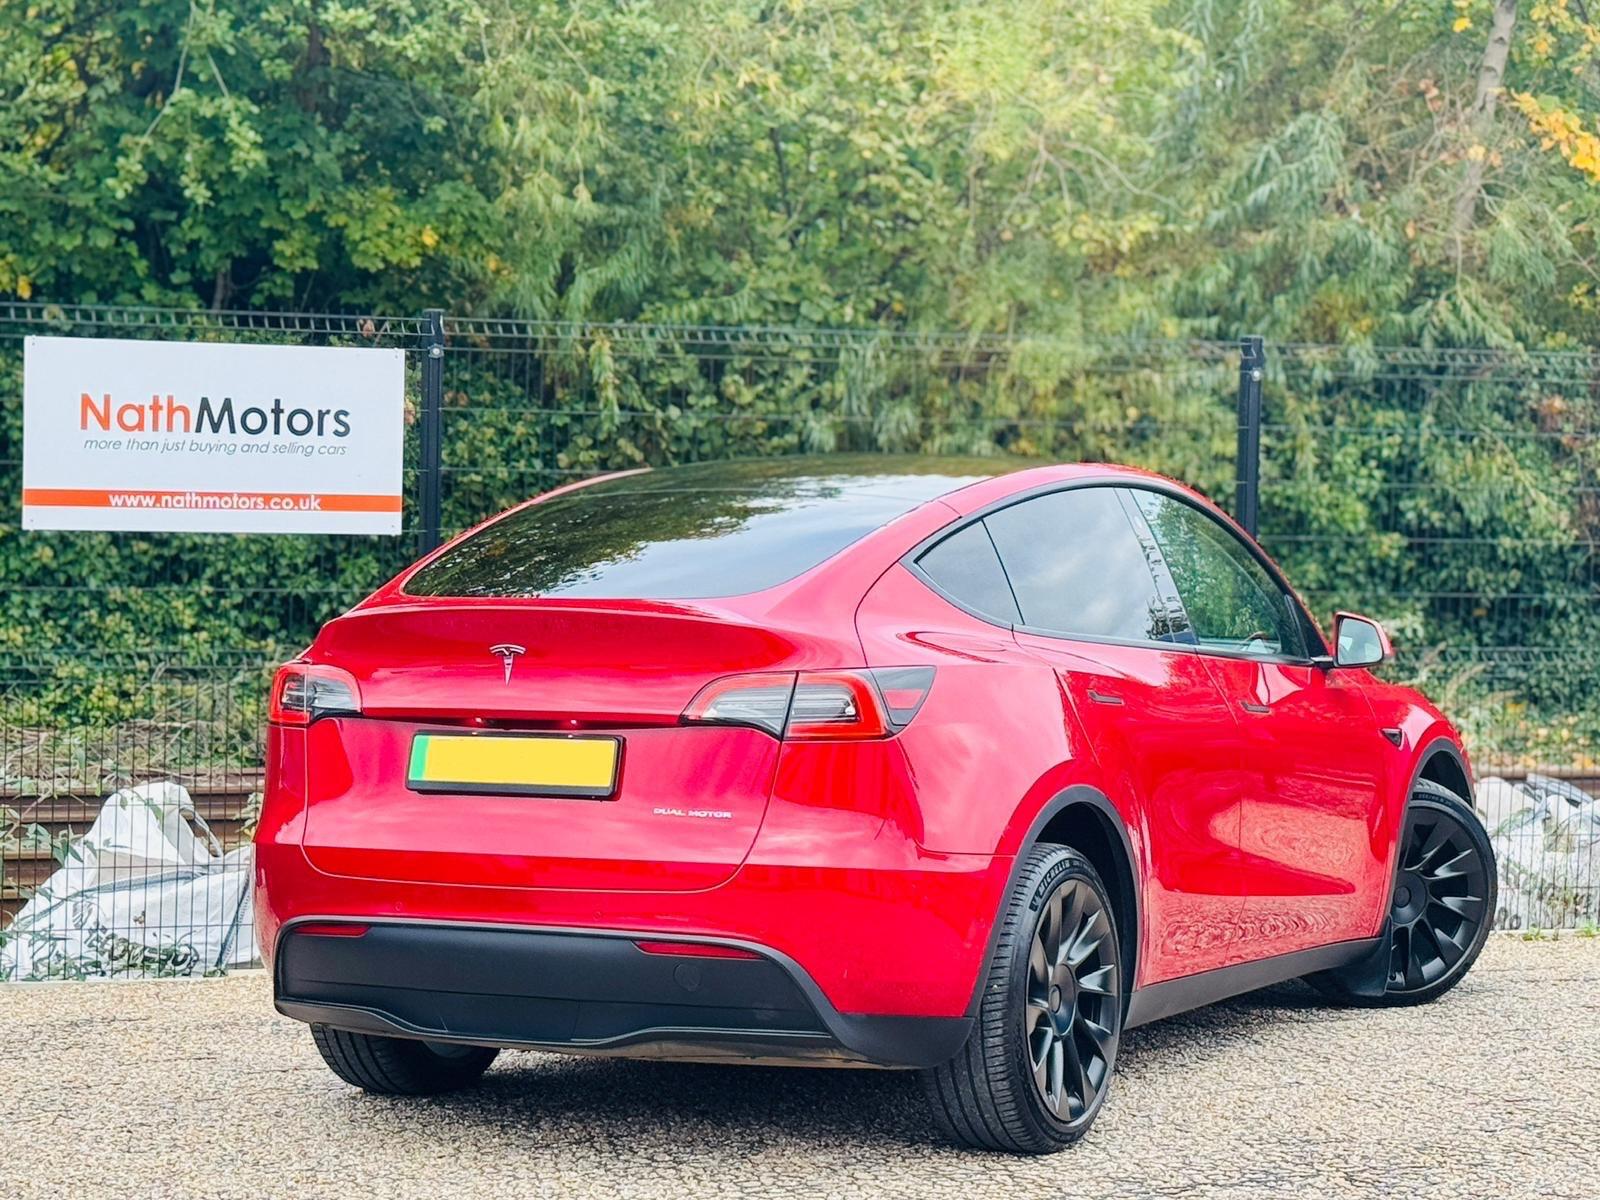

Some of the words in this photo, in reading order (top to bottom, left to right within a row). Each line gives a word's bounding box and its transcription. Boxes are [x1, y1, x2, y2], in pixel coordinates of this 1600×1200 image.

[80, 393, 351, 437] NathMotors
[83, 438, 122, 450] more
[126, 438, 159, 451] than
[160, 438, 187, 454] just
[188, 439, 238, 456] buying
[240, 441, 271, 454] and
[272, 441, 315, 457] selling
[317, 445, 348, 456] cars
[108, 492, 321, 510] www.nathmotors.co.uk
[653, 807, 687, 817] DUAL
[687, 810, 732, 819] MOTOR
